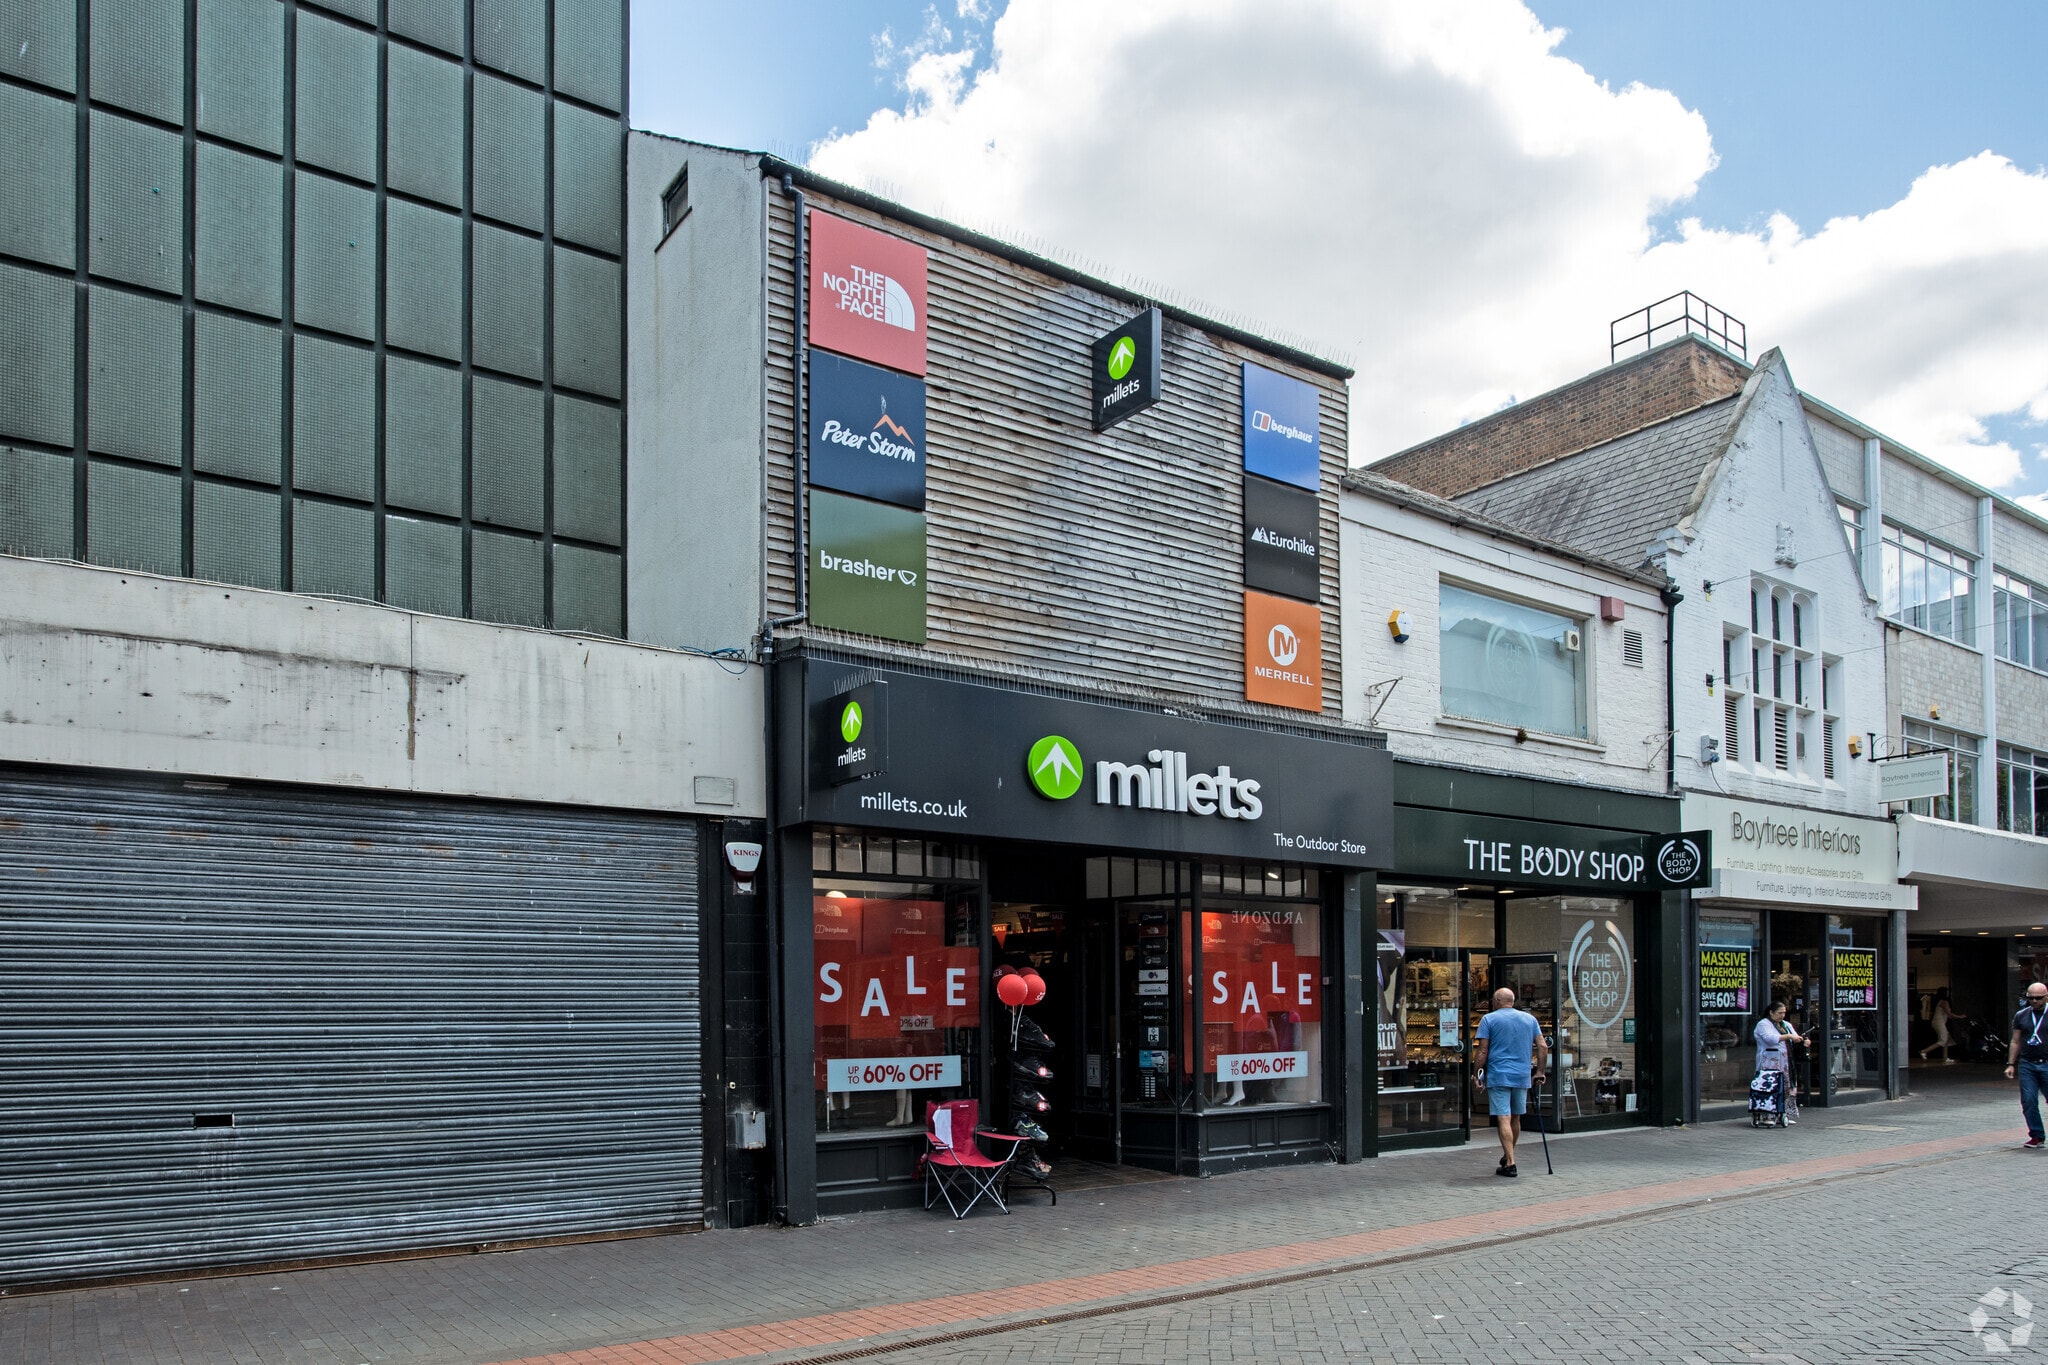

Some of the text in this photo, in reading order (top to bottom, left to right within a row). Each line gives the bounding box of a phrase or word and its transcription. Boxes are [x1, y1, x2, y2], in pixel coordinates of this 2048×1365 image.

[850, 264, 885, 291] THE
[823, 271, 885, 306] NORTH
[840, 294, 885, 323] FACE
[1103, 379, 1140, 409] millets
[1270, 419, 1313, 444] berghaus
[820, 420, 916, 463] Peter Storm
[1269, 531, 1315, 557] Eurohike
[820, 549, 897, 582] brasher
[1254, 665, 1314, 687] MERRELL
[837, 746, 867, 767] millets
[1096, 749, 1263, 820] millets
[1881, 774, 1909, 783] Baytree
[1911, 769, 1940, 778] Interiors
[861, 792, 968, 818] millets.co.uk
[1731, 811, 1862, 856] Baytree Interiors
[733, 849, 760, 857] KINGS
[1273, 832, 1367, 855] The Outdoor Store
[1463, 838, 1645, 882] THE BODY SHOP
[1665, 858, 1692, 868] BODY
[1671, 851, 1686, 859] THE
[1667, 866, 1692, 875] SHOP
[1726, 857, 1864, 880] Furniture, Lighting, Interior Accessories and Gifts
[1756, 880, 1892, 902] Furniture, Lighting, Interior Accessories and Gifts
[1589, 953, 1611, 968] THE
[1701, 951, 1747, 966] MASSIVE
[1836, 953, 1873, 967] MASSIVE
[1581, 970, 1620, 989] BODY
[1701, 966, 1747, 978] WAREHOUSE
[1836, 967, 1873, 977] WAREHOUSE
[819, 955, 966, 1017] SALE
[1212, 961, 1312, 1014] SALE
[1701, 977, 1747, 989] CLEARANCE
[1836, 977, 1874, 987] CLEARANCE
[1583, 990, 1618, 1009] SHOP
[1701, 991, 1716, 1000] SAVE
[1836, 989, 1849, 998] SAVE
[1701, 1000, 1717, 1008] UP TO
[914, 1018, 928, 1028] OFF
[847, 1065, 860, 1075] UP
[863, 1063, 943, 1083] 60% OFF
[1230, 1060, 1240, 1068] UP
[1230, 1068, 1240, 1076] TO
[1241, 1057, 1296, 1074] 60% OFF
[847, 1075, 860, 1085] TO
